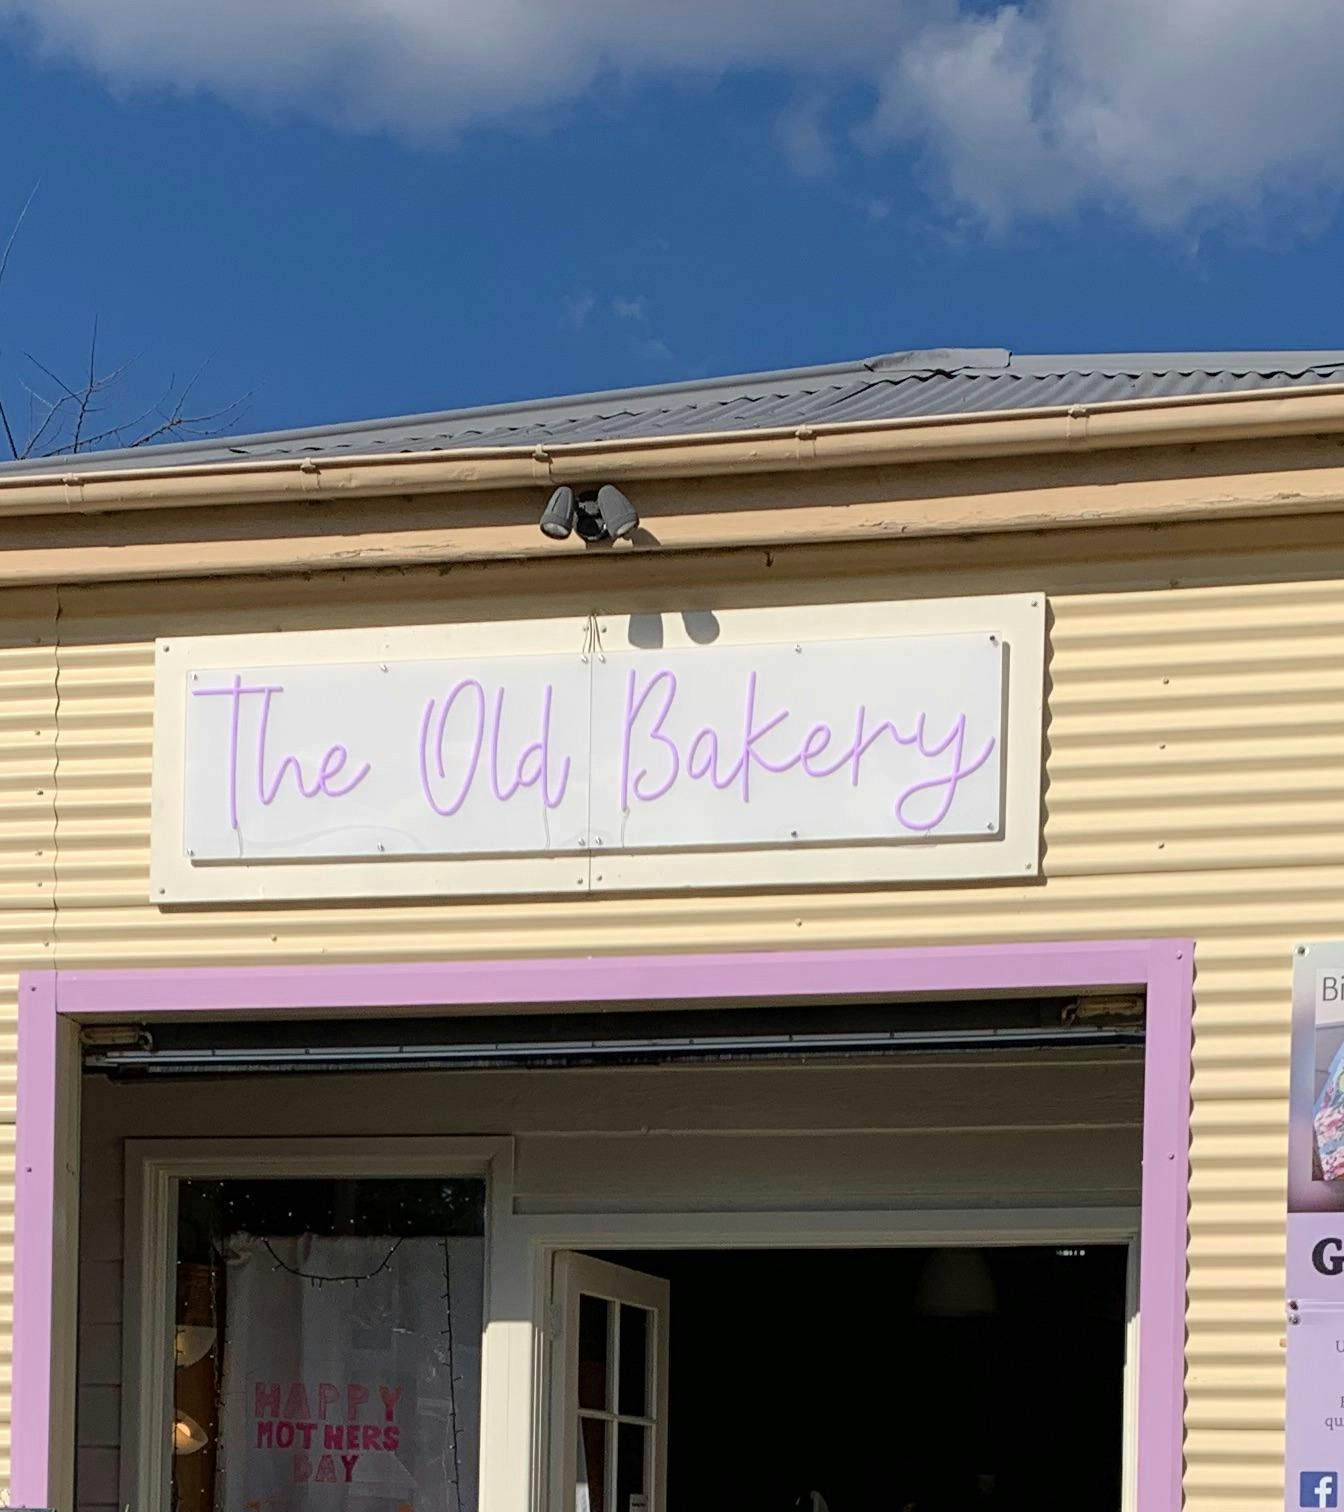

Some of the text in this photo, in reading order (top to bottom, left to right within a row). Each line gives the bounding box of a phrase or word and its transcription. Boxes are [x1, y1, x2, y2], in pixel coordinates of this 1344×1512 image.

[192, 668, 996, 832] The Old Bakery
[254, 1382, 402, 1422] HAPPY
[291, 1454, 360, 1483] DAY
